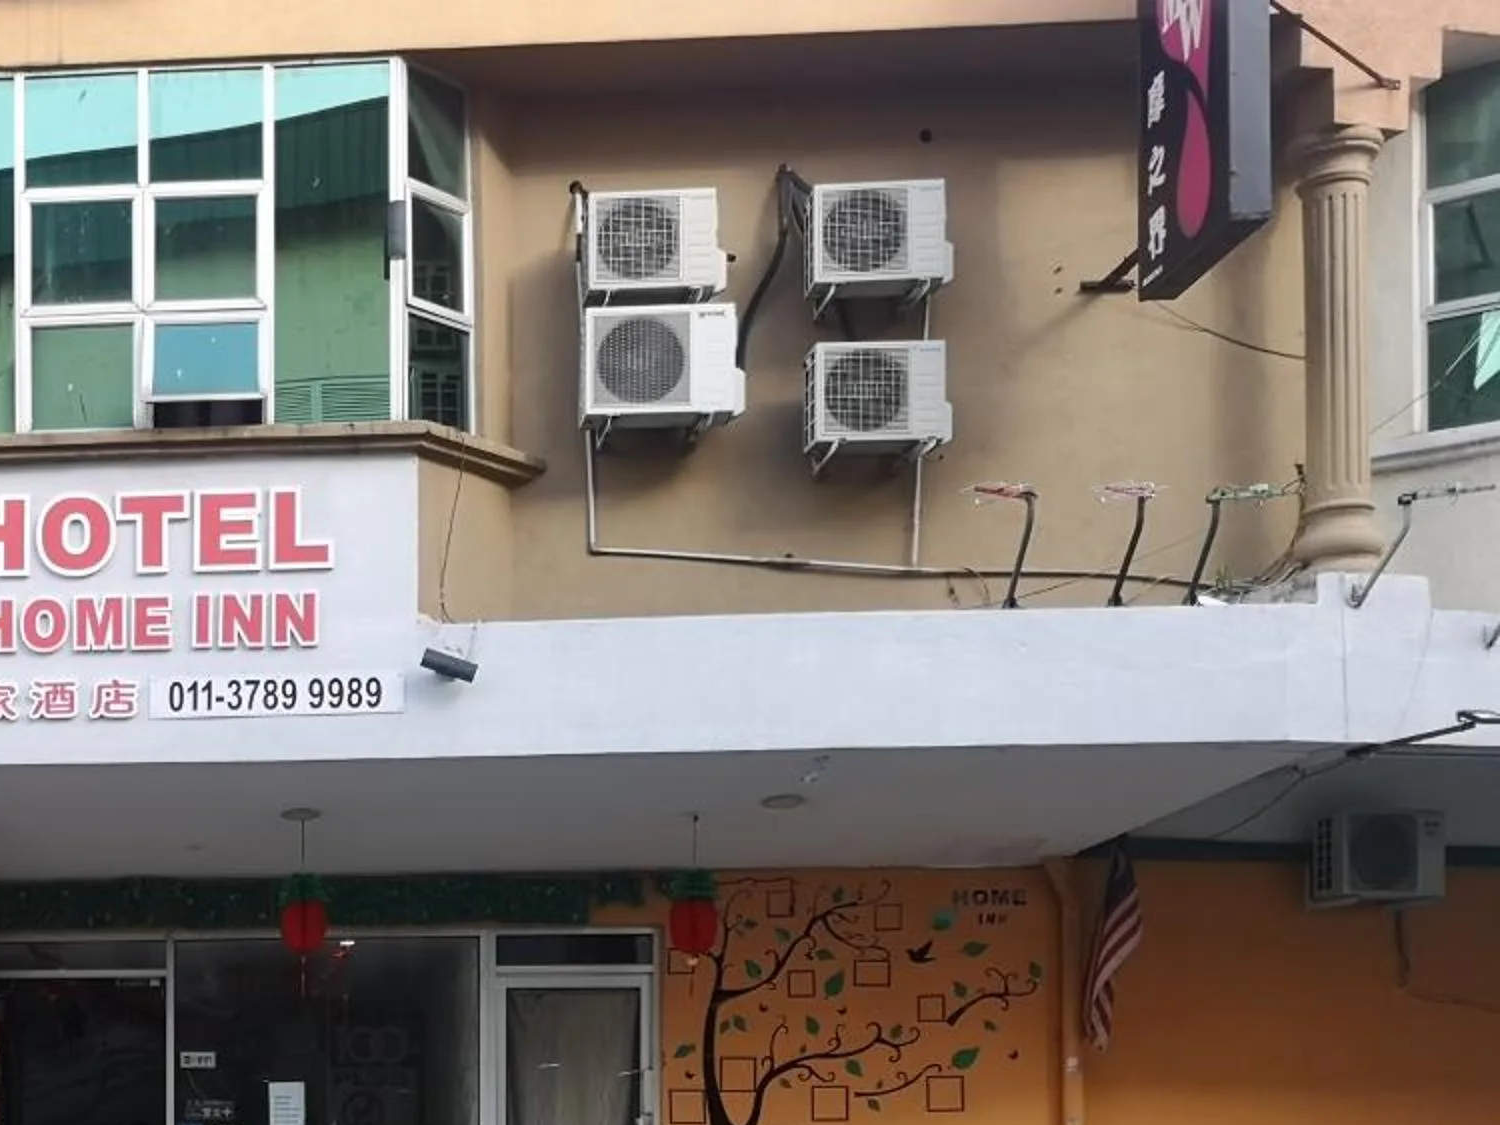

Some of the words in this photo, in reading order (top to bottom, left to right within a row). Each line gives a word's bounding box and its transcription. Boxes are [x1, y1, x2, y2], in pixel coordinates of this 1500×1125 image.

[193, 589, 318, 648] INN
[168, 680, 296, 711] 011-3789
[308, 677, 382, 708] 9989
[952, 888, 1028, 906] HOME
